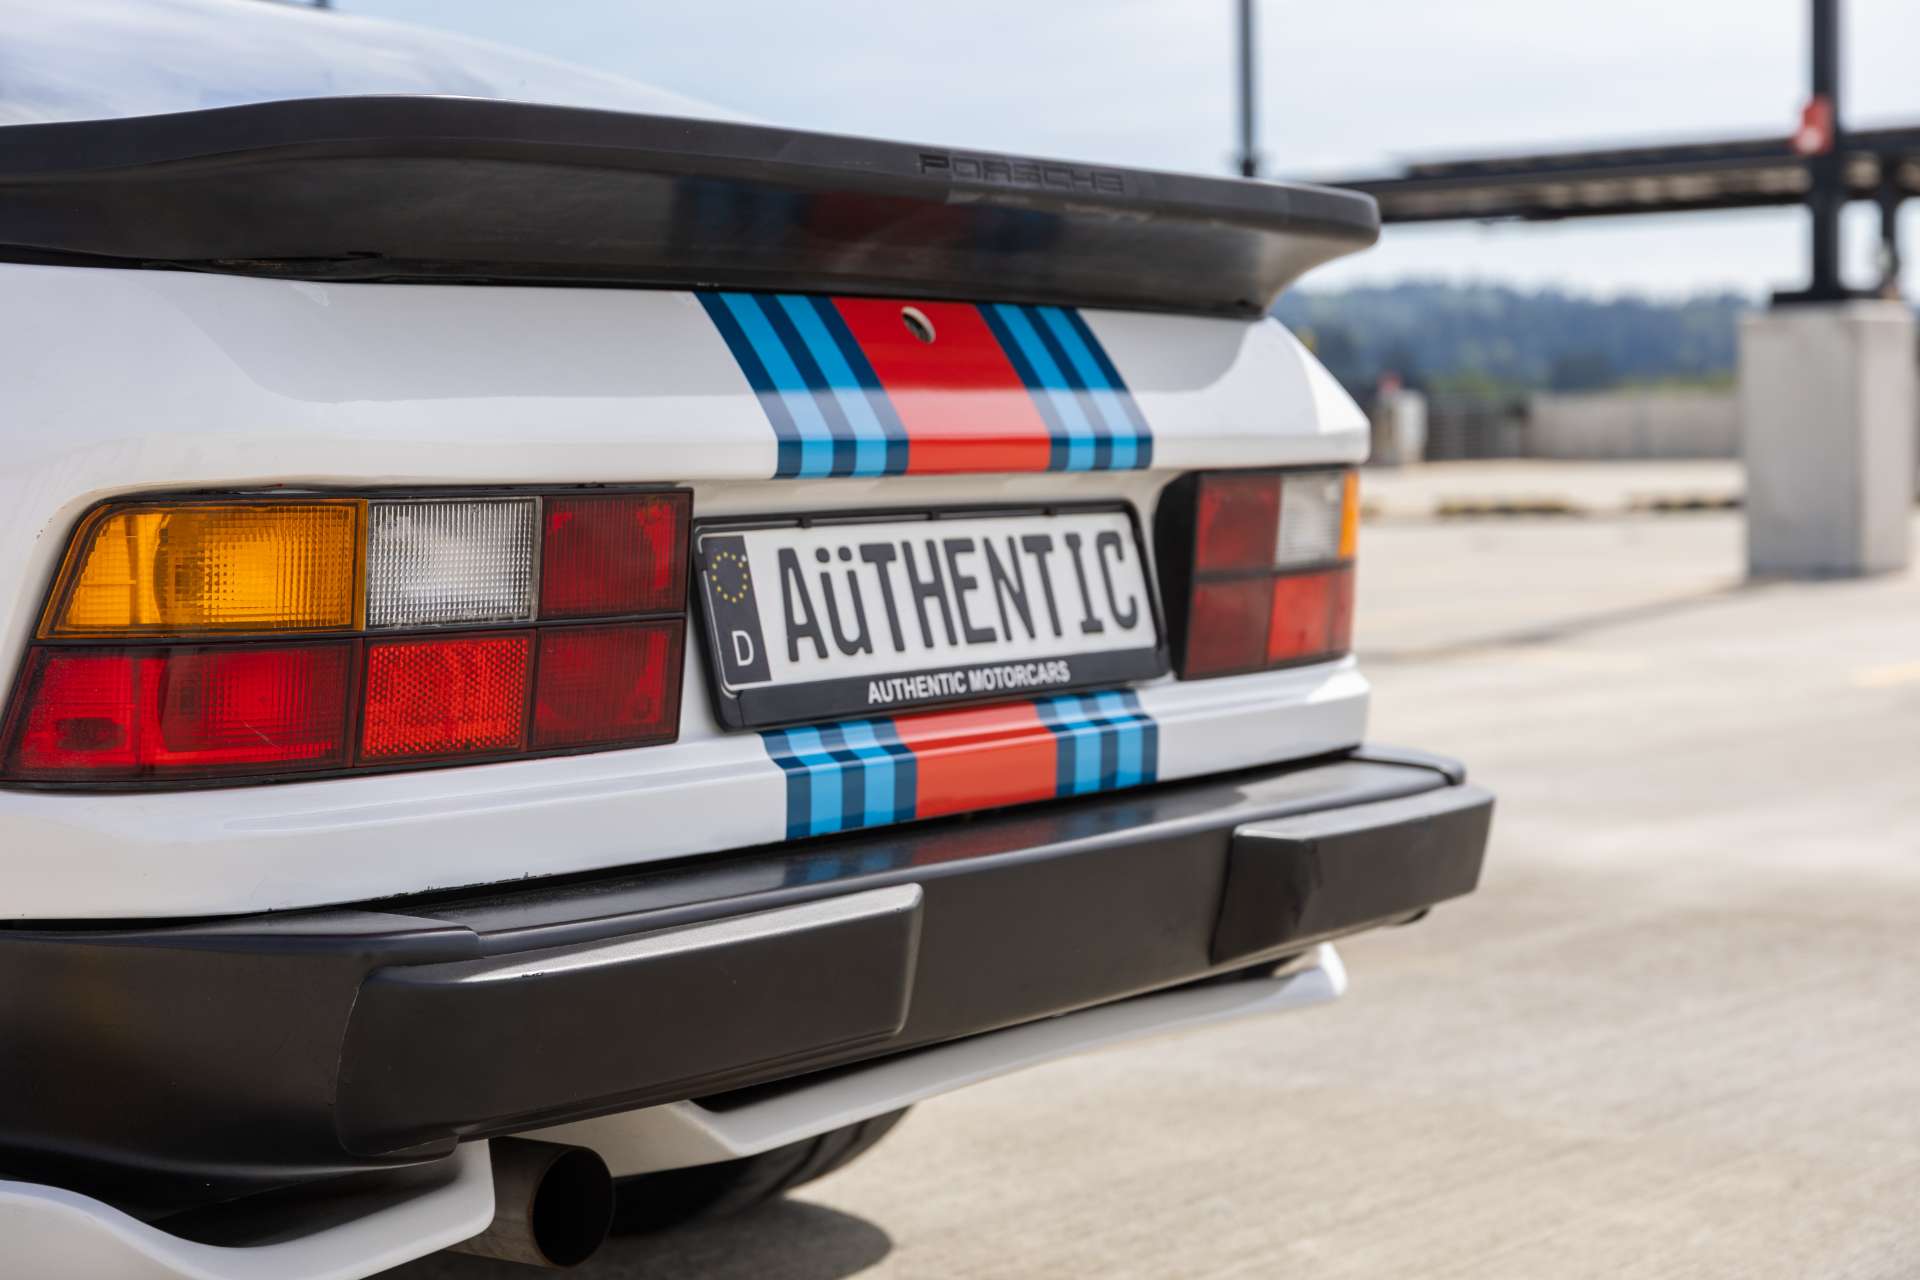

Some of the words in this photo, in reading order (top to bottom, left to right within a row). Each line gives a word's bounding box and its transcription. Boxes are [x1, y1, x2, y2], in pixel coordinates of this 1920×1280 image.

[918, 152, 1125, 193] PORSCHE
[731, 629, 754, 667] D
[867, 671, 967, 704] AUTHENTIC
[968, 660, 1071, 692] MOTORCARS
